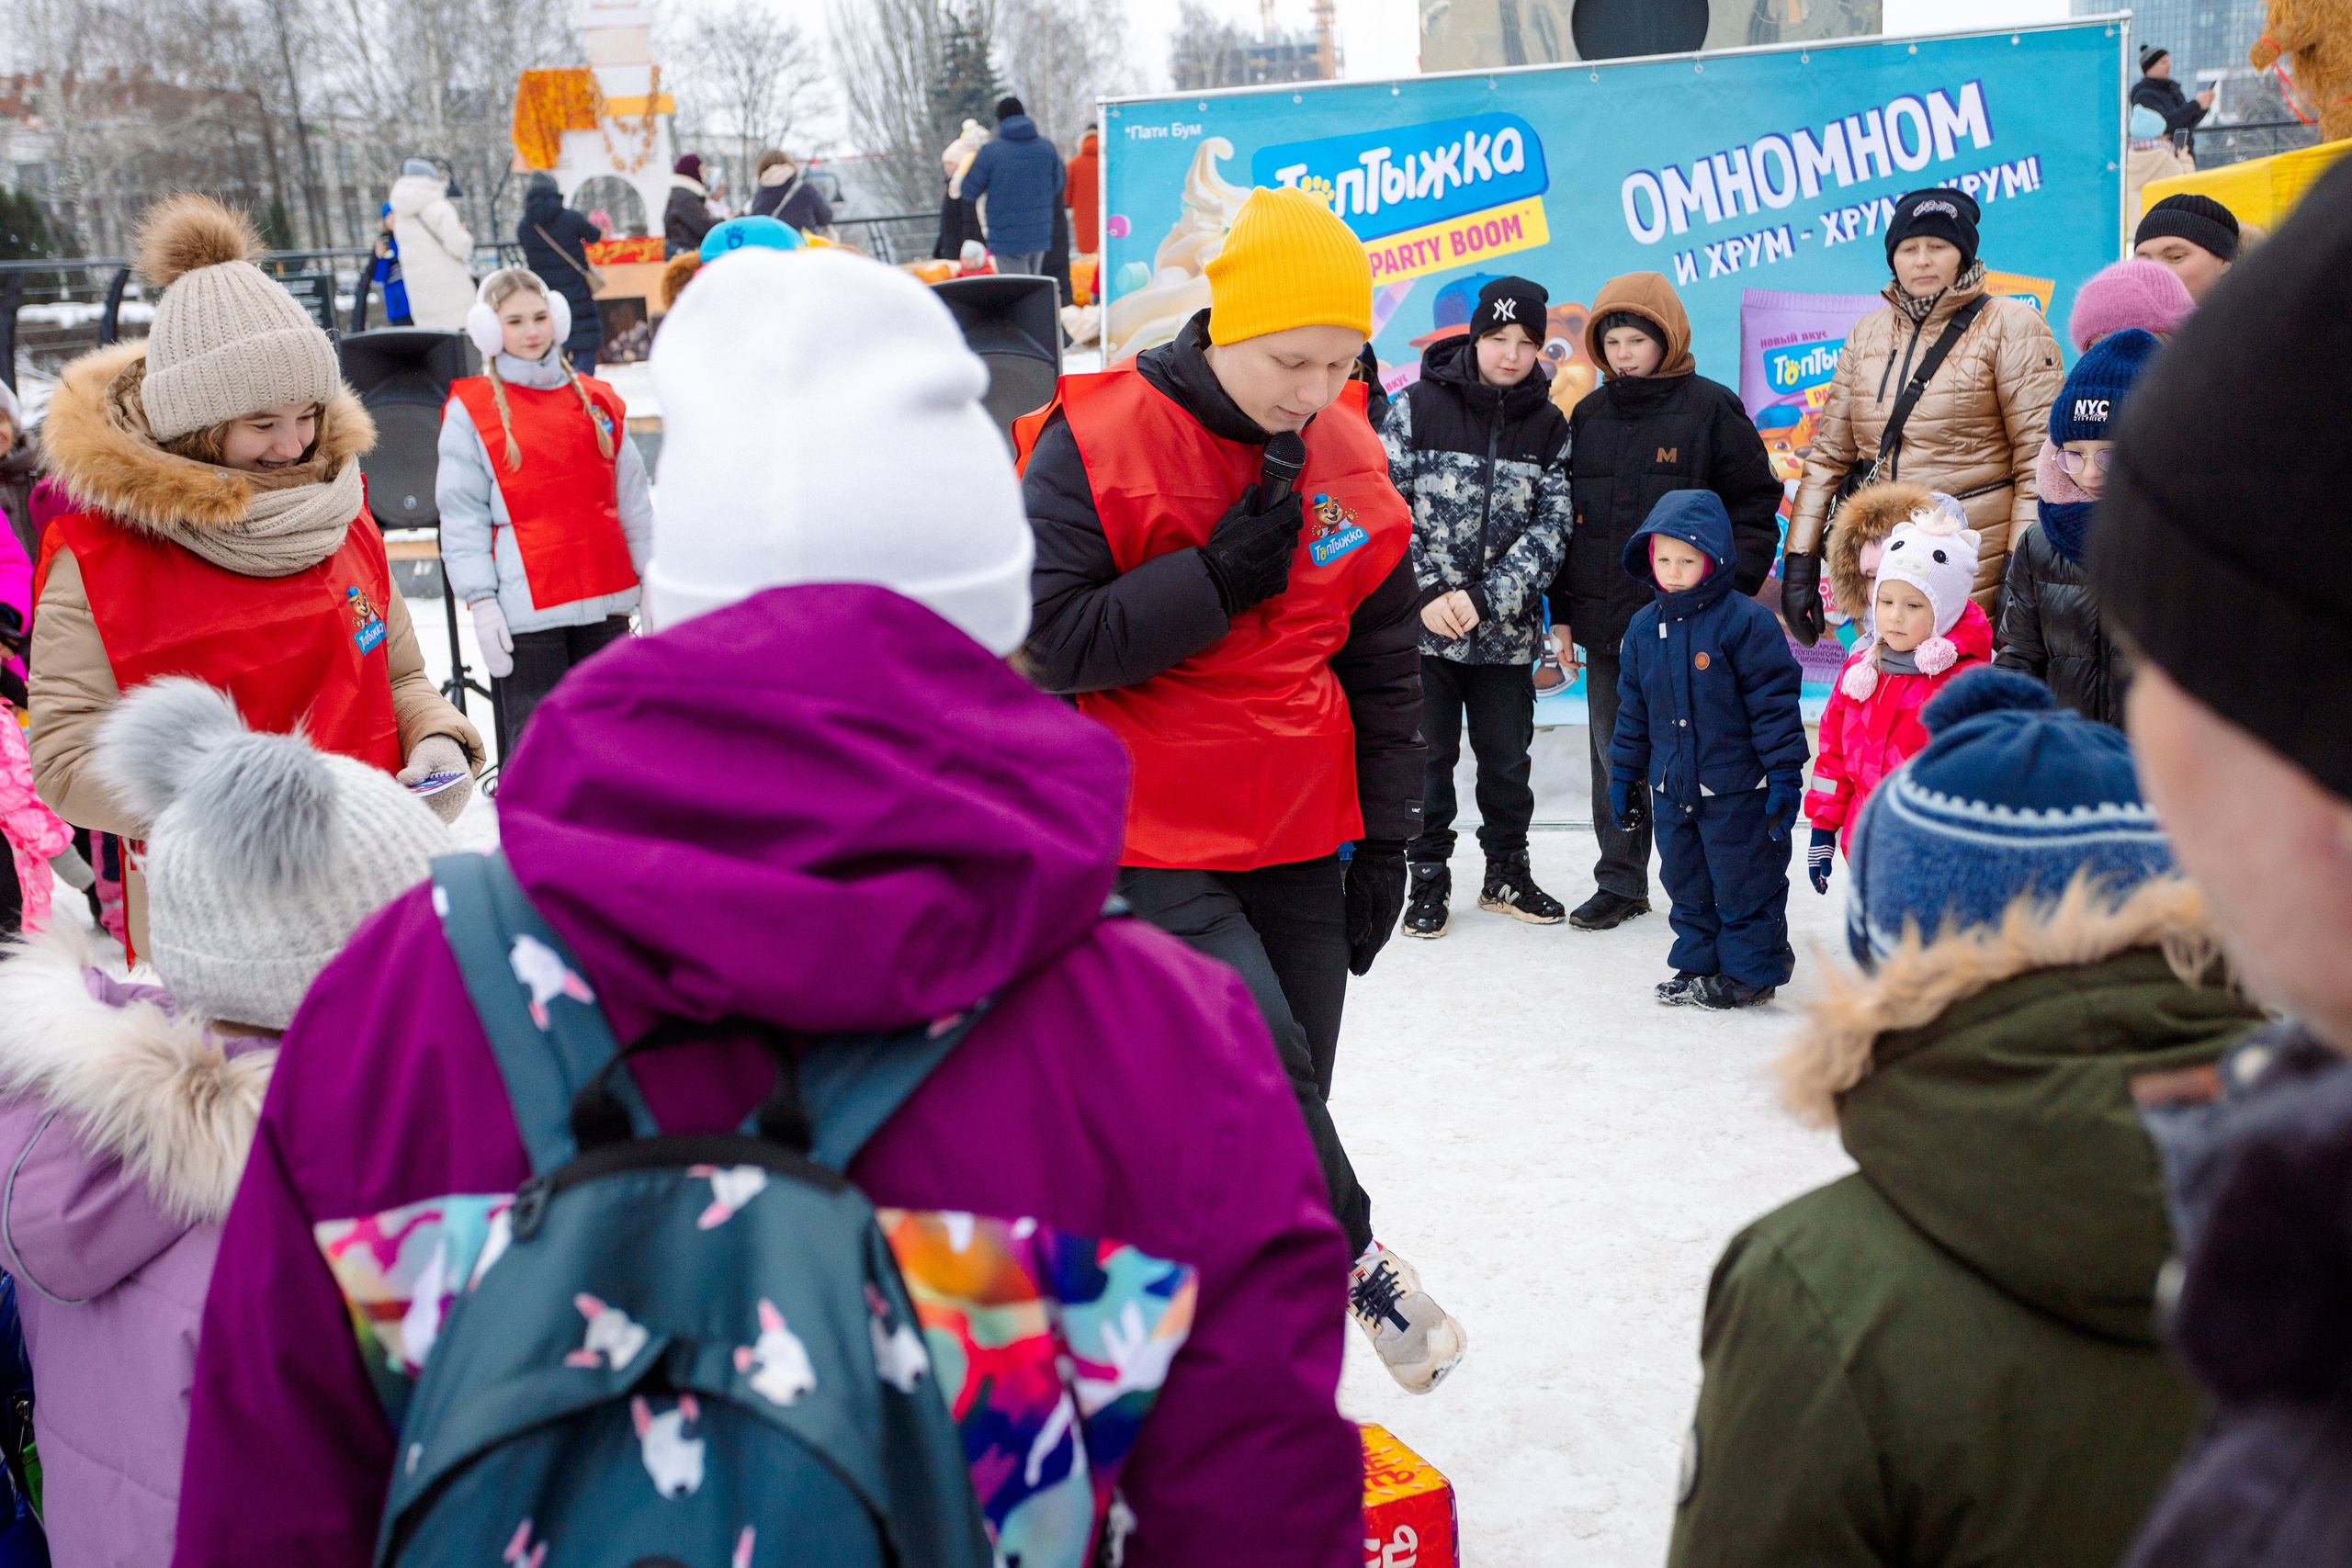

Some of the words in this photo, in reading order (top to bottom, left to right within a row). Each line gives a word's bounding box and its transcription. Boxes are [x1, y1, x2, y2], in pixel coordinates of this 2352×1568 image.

[1171, 122, 1203, 140] Бум
[1621, 81, 1992, 245] ОМНОМНОМ
[1370, 235, 1442, 278] PARTY
[1703, 225, 1794, 279] ХРУМ
[2075, 399, 2110, 416] NYC
[1657, 447, 1678, 463] M
